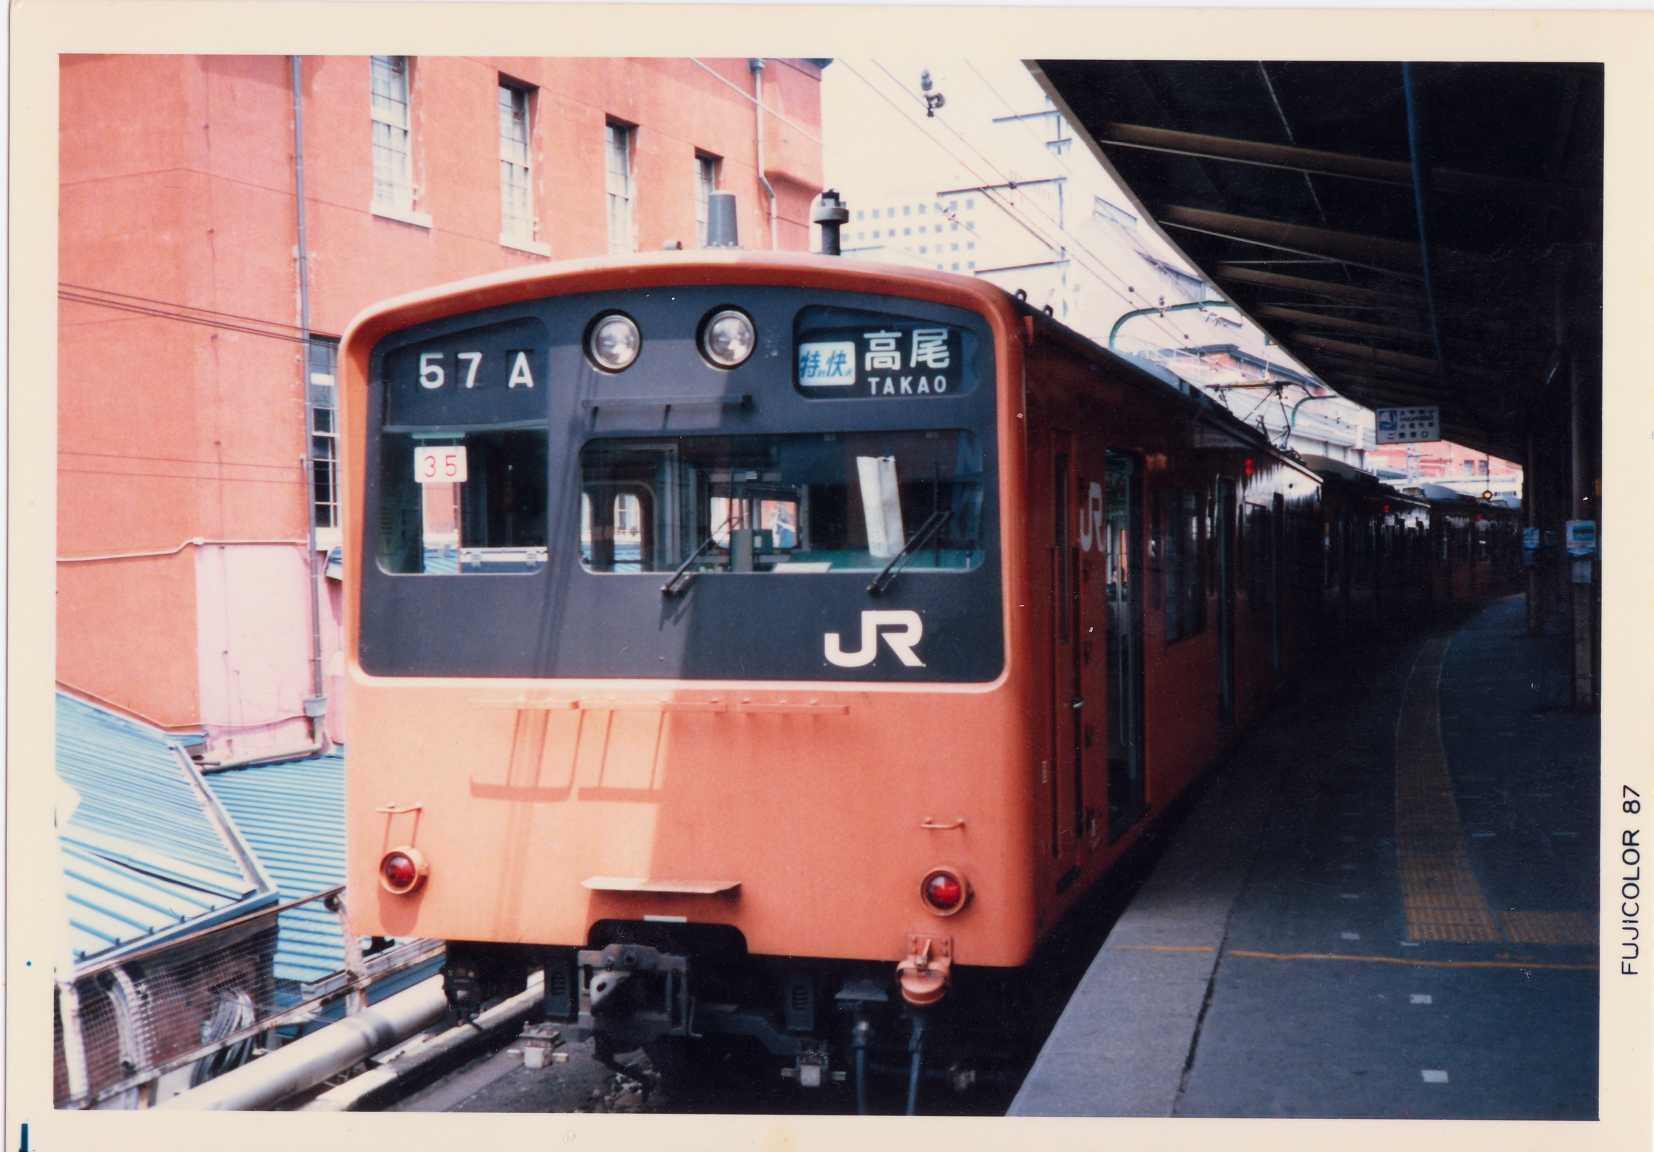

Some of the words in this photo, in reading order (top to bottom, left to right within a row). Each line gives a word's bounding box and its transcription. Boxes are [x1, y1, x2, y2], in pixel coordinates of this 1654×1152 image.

[863, 328, 951, 371] 高尾
[868, 376, 947, 395] TAKAO
[423, 454, 457, 478] 35
[1079, 481, 1106, 552] JR
[824, 610, 926, 667] JR
